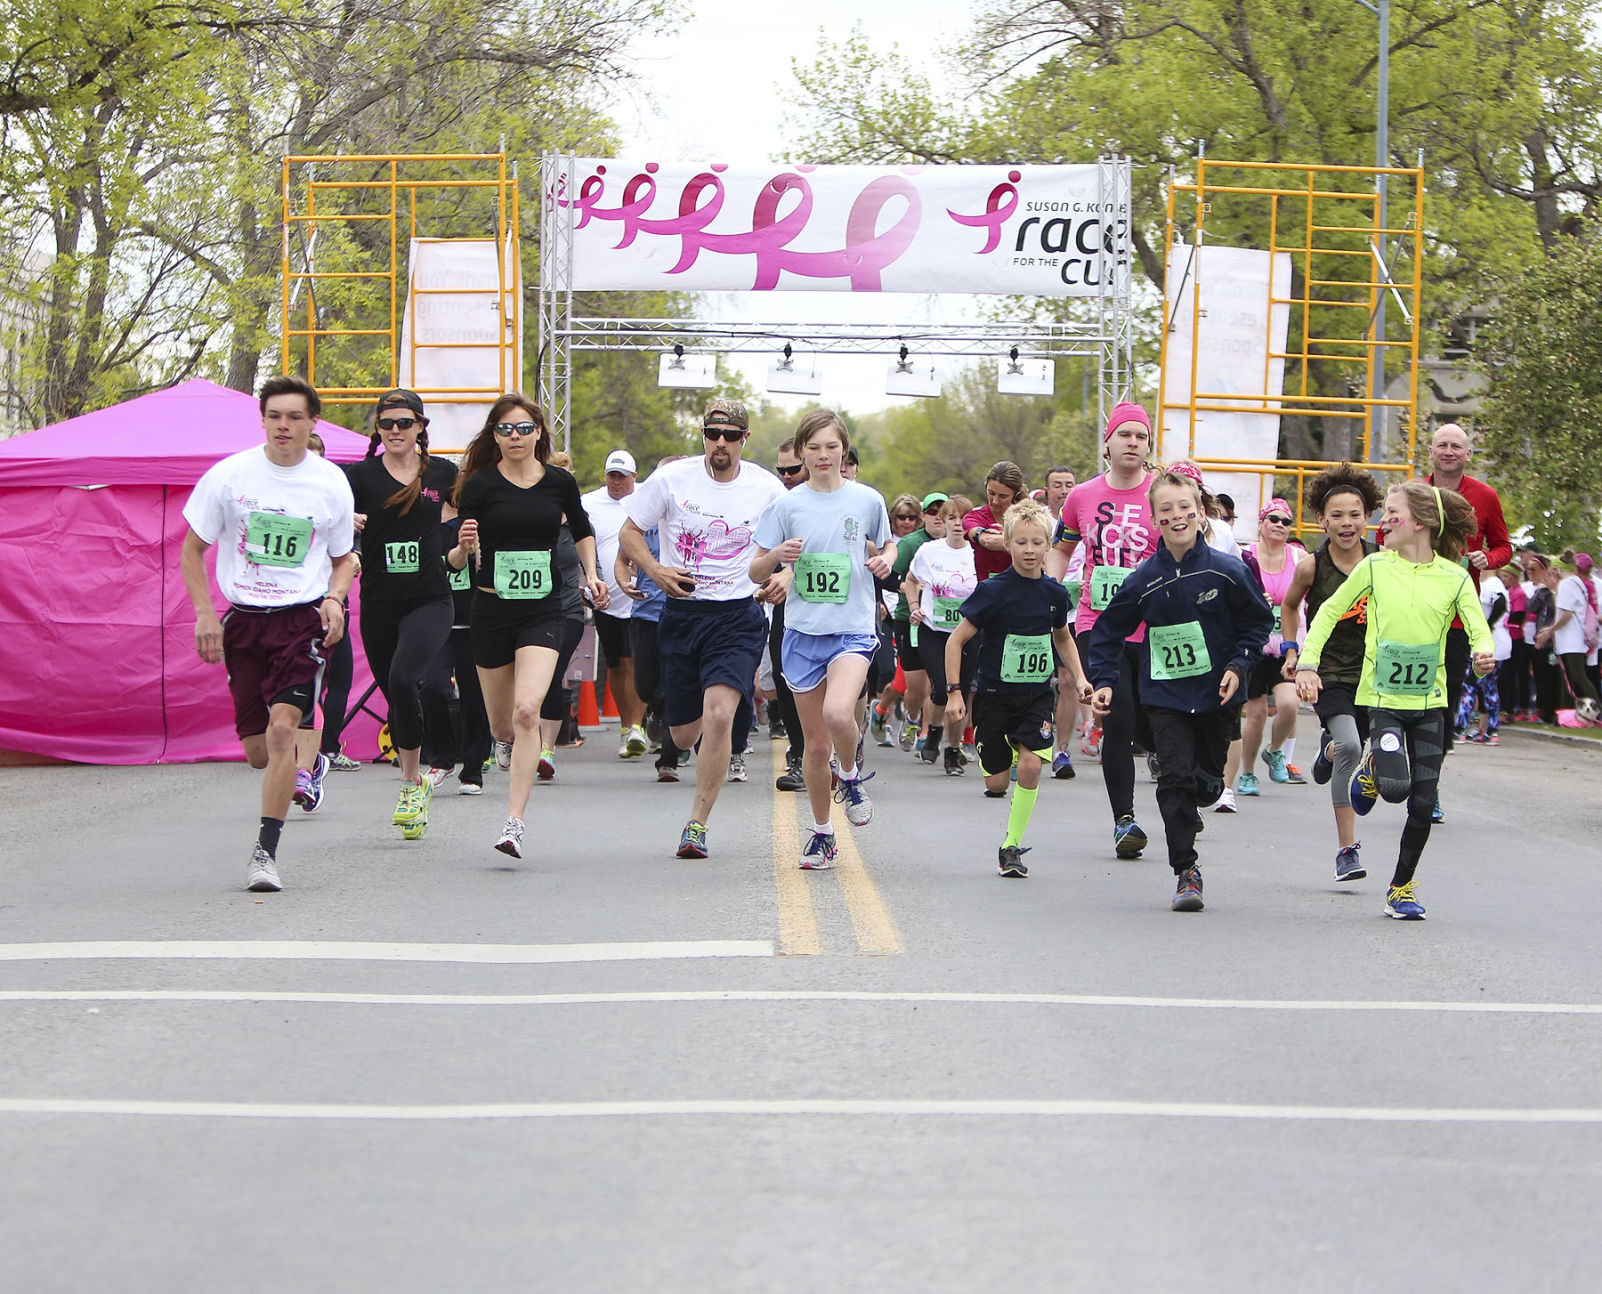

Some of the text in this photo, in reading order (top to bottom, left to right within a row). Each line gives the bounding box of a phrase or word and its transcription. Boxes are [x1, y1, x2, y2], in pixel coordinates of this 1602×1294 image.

[1073, 202, 1084, 213] G.
[1013, 258, 1059, 267] FOR THE
[1095, 501, 1143, 527] SHE
[263, 532, 298, 558] 116
[386, 545, 418, 564] 148
[508, 569, 542, 590] 209
[806, 571, 840, 593] 192
[945, 609, 959, 622] 80
[1016, 652, 1048, 673] 196
[1162, 643, 1197, 669] 213
[1388, 661, 1430, 685] 212
